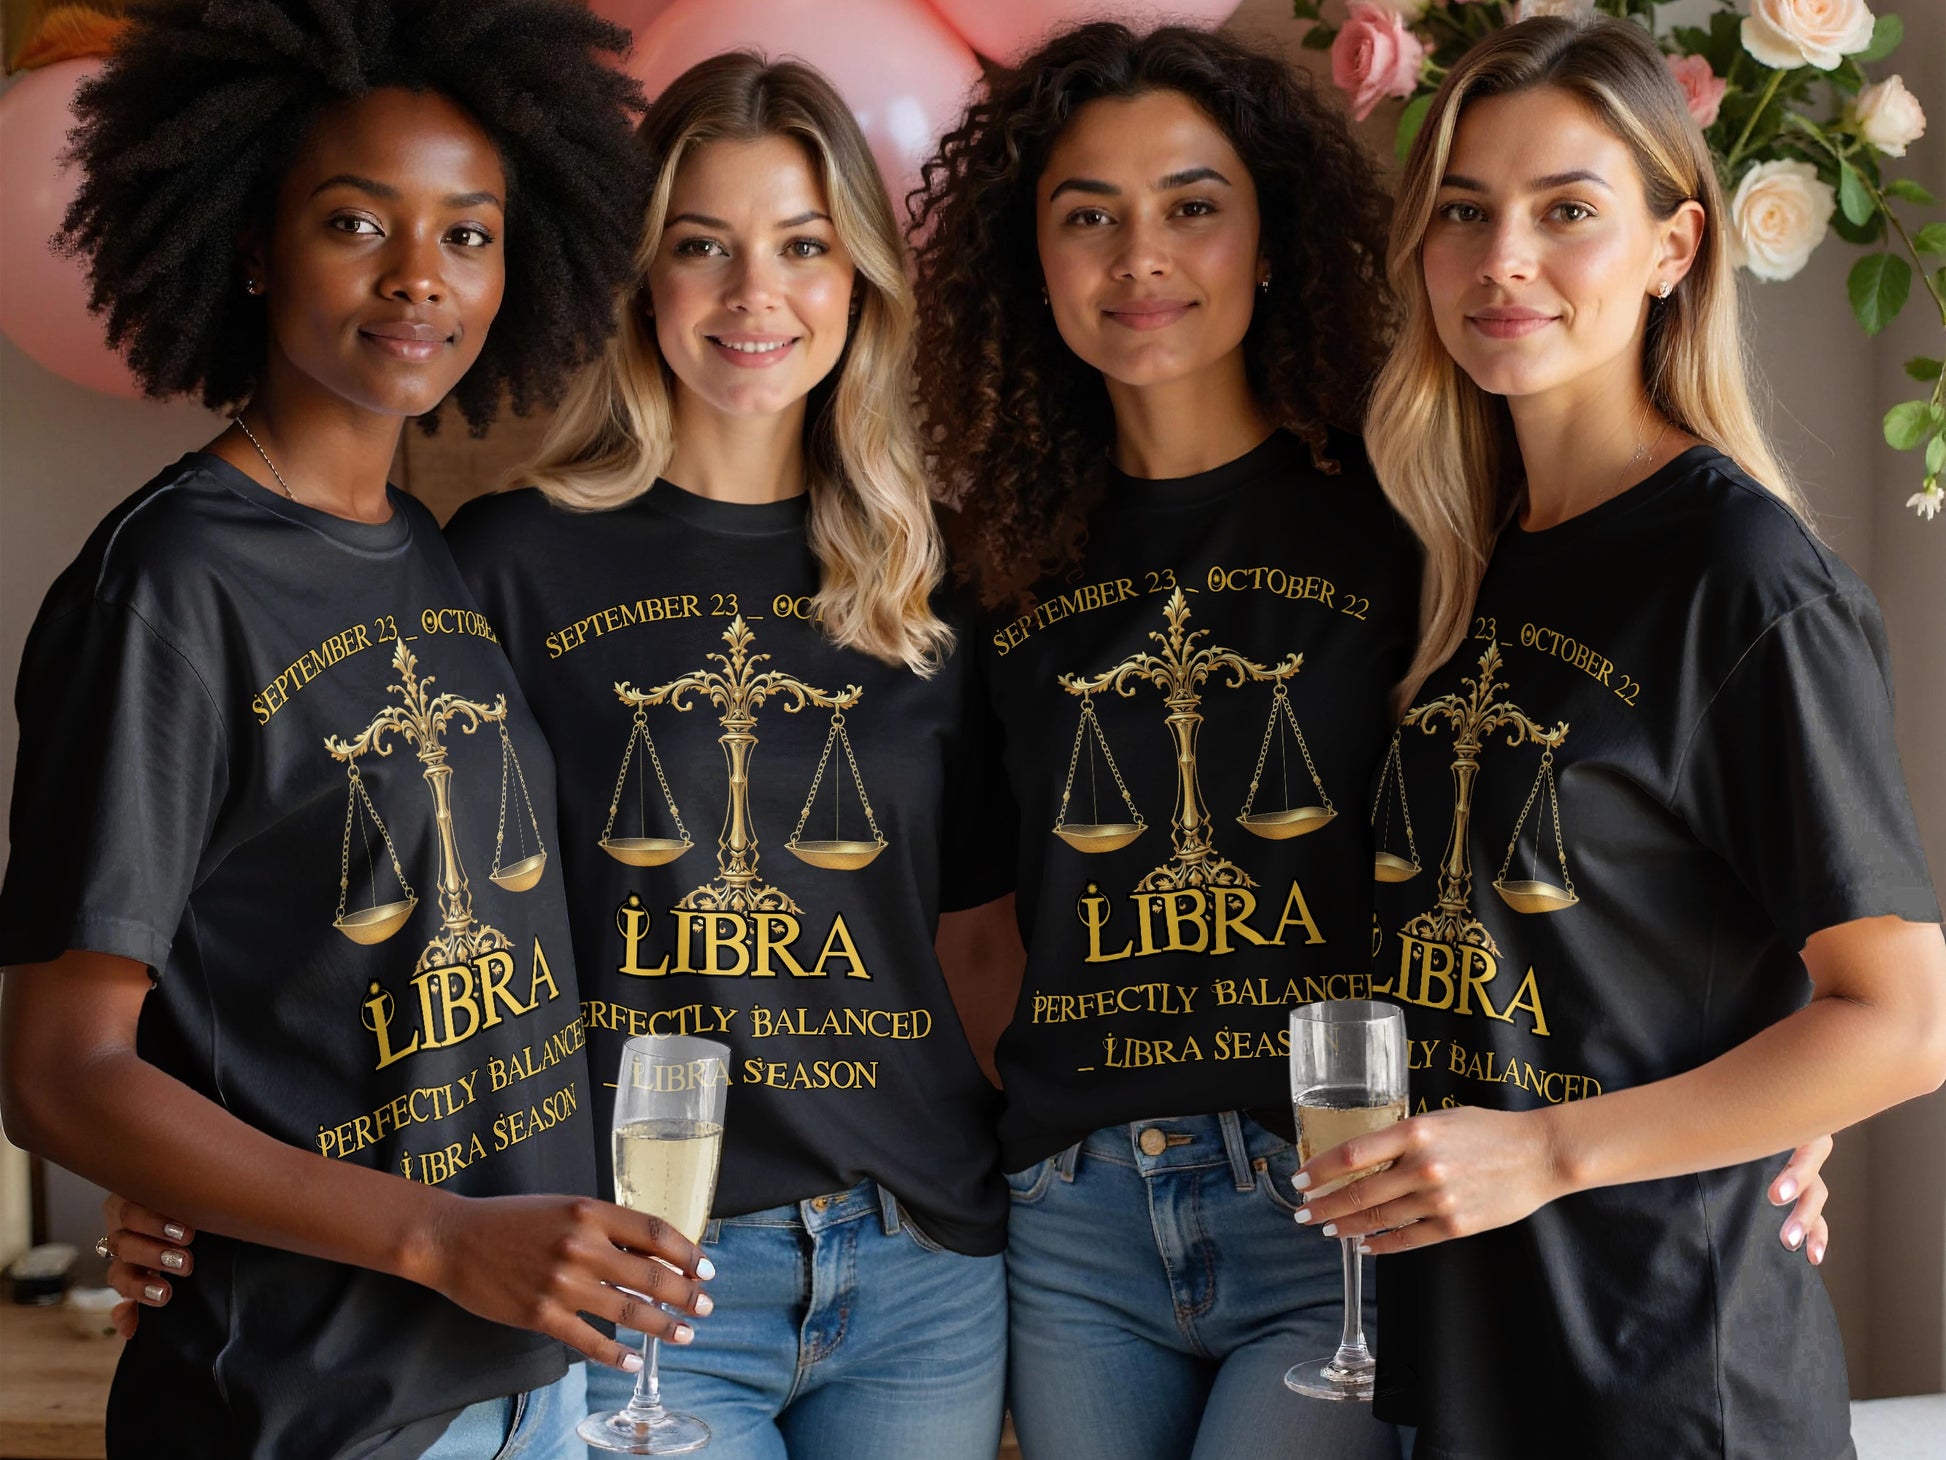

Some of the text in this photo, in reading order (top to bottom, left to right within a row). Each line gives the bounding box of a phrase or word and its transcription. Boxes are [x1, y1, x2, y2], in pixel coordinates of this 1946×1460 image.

[545, 594, 702, 659] SEPTEMBER
[710, 593, 739, 617] 23
[993, 577, 1140, 656] SEPTEMBER
[1145, 569, 1177, 594] 23
[1207, 566, 1335, 608] OCTOBER
[1341, 594, 1370, 621] 22
[252, 623, 373, 726] SEPTEMBER
[374, 615, 398, 642] 23
[421, 608, 497, 644] OCTOBE
[1475, 617, 1496, 640] 23
[1521, 623, 1614, 687] OCTOBER
[1614, 675, 1640, 706] 22
[617, 894, 871, 980] LIBRA
[1078, 879, 1326, 963] LIBRA
[361, 935, 560, 1071] LIBRA
[580, 1000, 932, 1040] ERFECTLY BALANCED
[1031, 983, 1199, 1024] PERFECTLY
[631, 1056, 734, 1093] LIBRA
[743, 1056, 879, 1090] SEASON
[1102, 1032, 1204, 1069] LIBRA
[1448, 1039, 1602, 1104] BALANCED
[316, 1069, 478, 1159] PERFECTLY
[494, 1083, 578, 1152] SEASON
